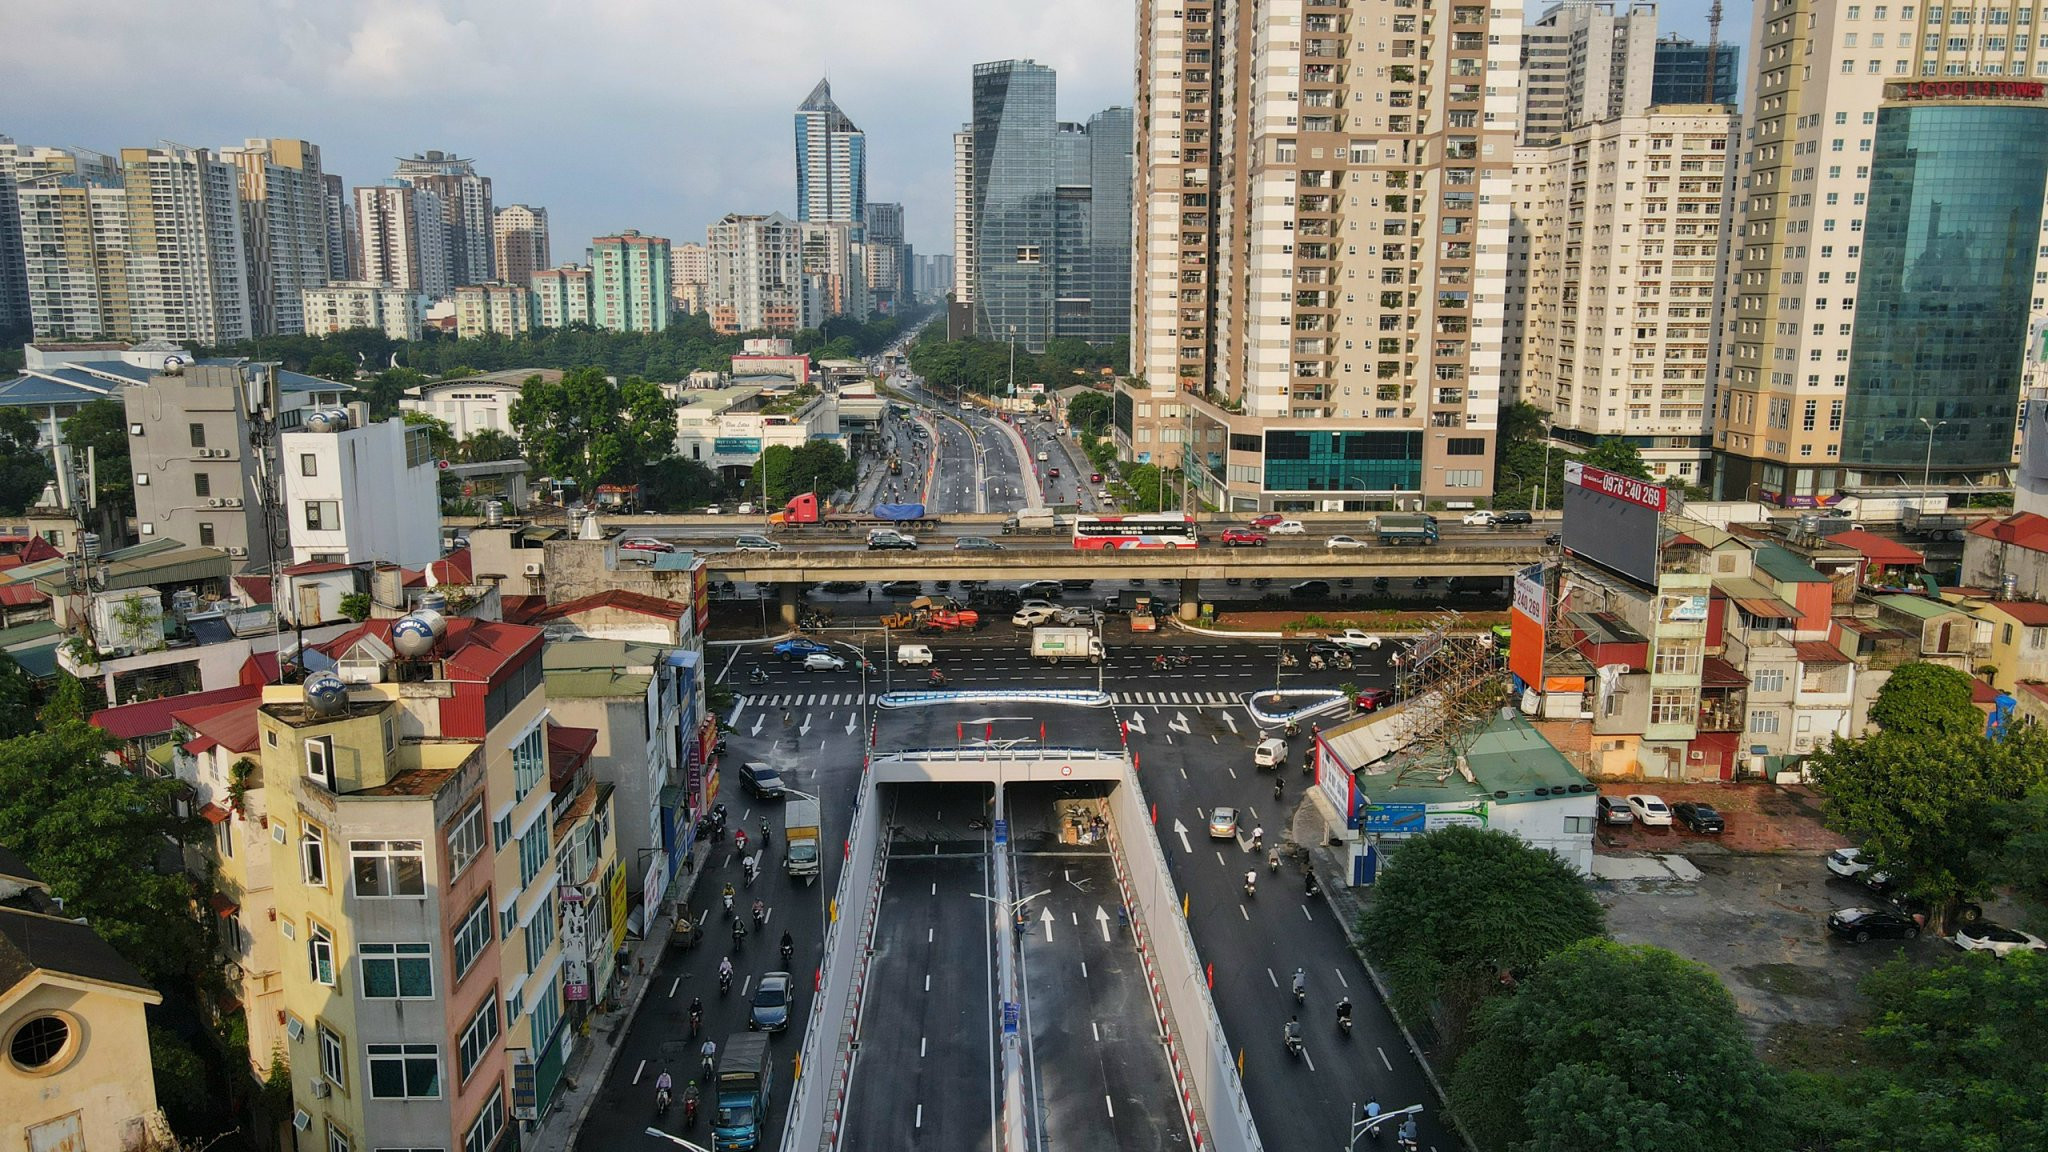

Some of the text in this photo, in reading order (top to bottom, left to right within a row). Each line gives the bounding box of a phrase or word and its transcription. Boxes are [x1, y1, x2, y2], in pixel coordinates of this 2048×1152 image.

[1907, 82, 2044, 97] LICOGI 13 TOWER
[1602, 474, 1624, 495] 0976
[1624, 481, 1641, 500] 240
[1642, 486, 1660, 507] 269
[1517, 590, 1528, 610] 240
[1529, 598, 1540, 618] 269
[572, 986, 582, 994] 28
